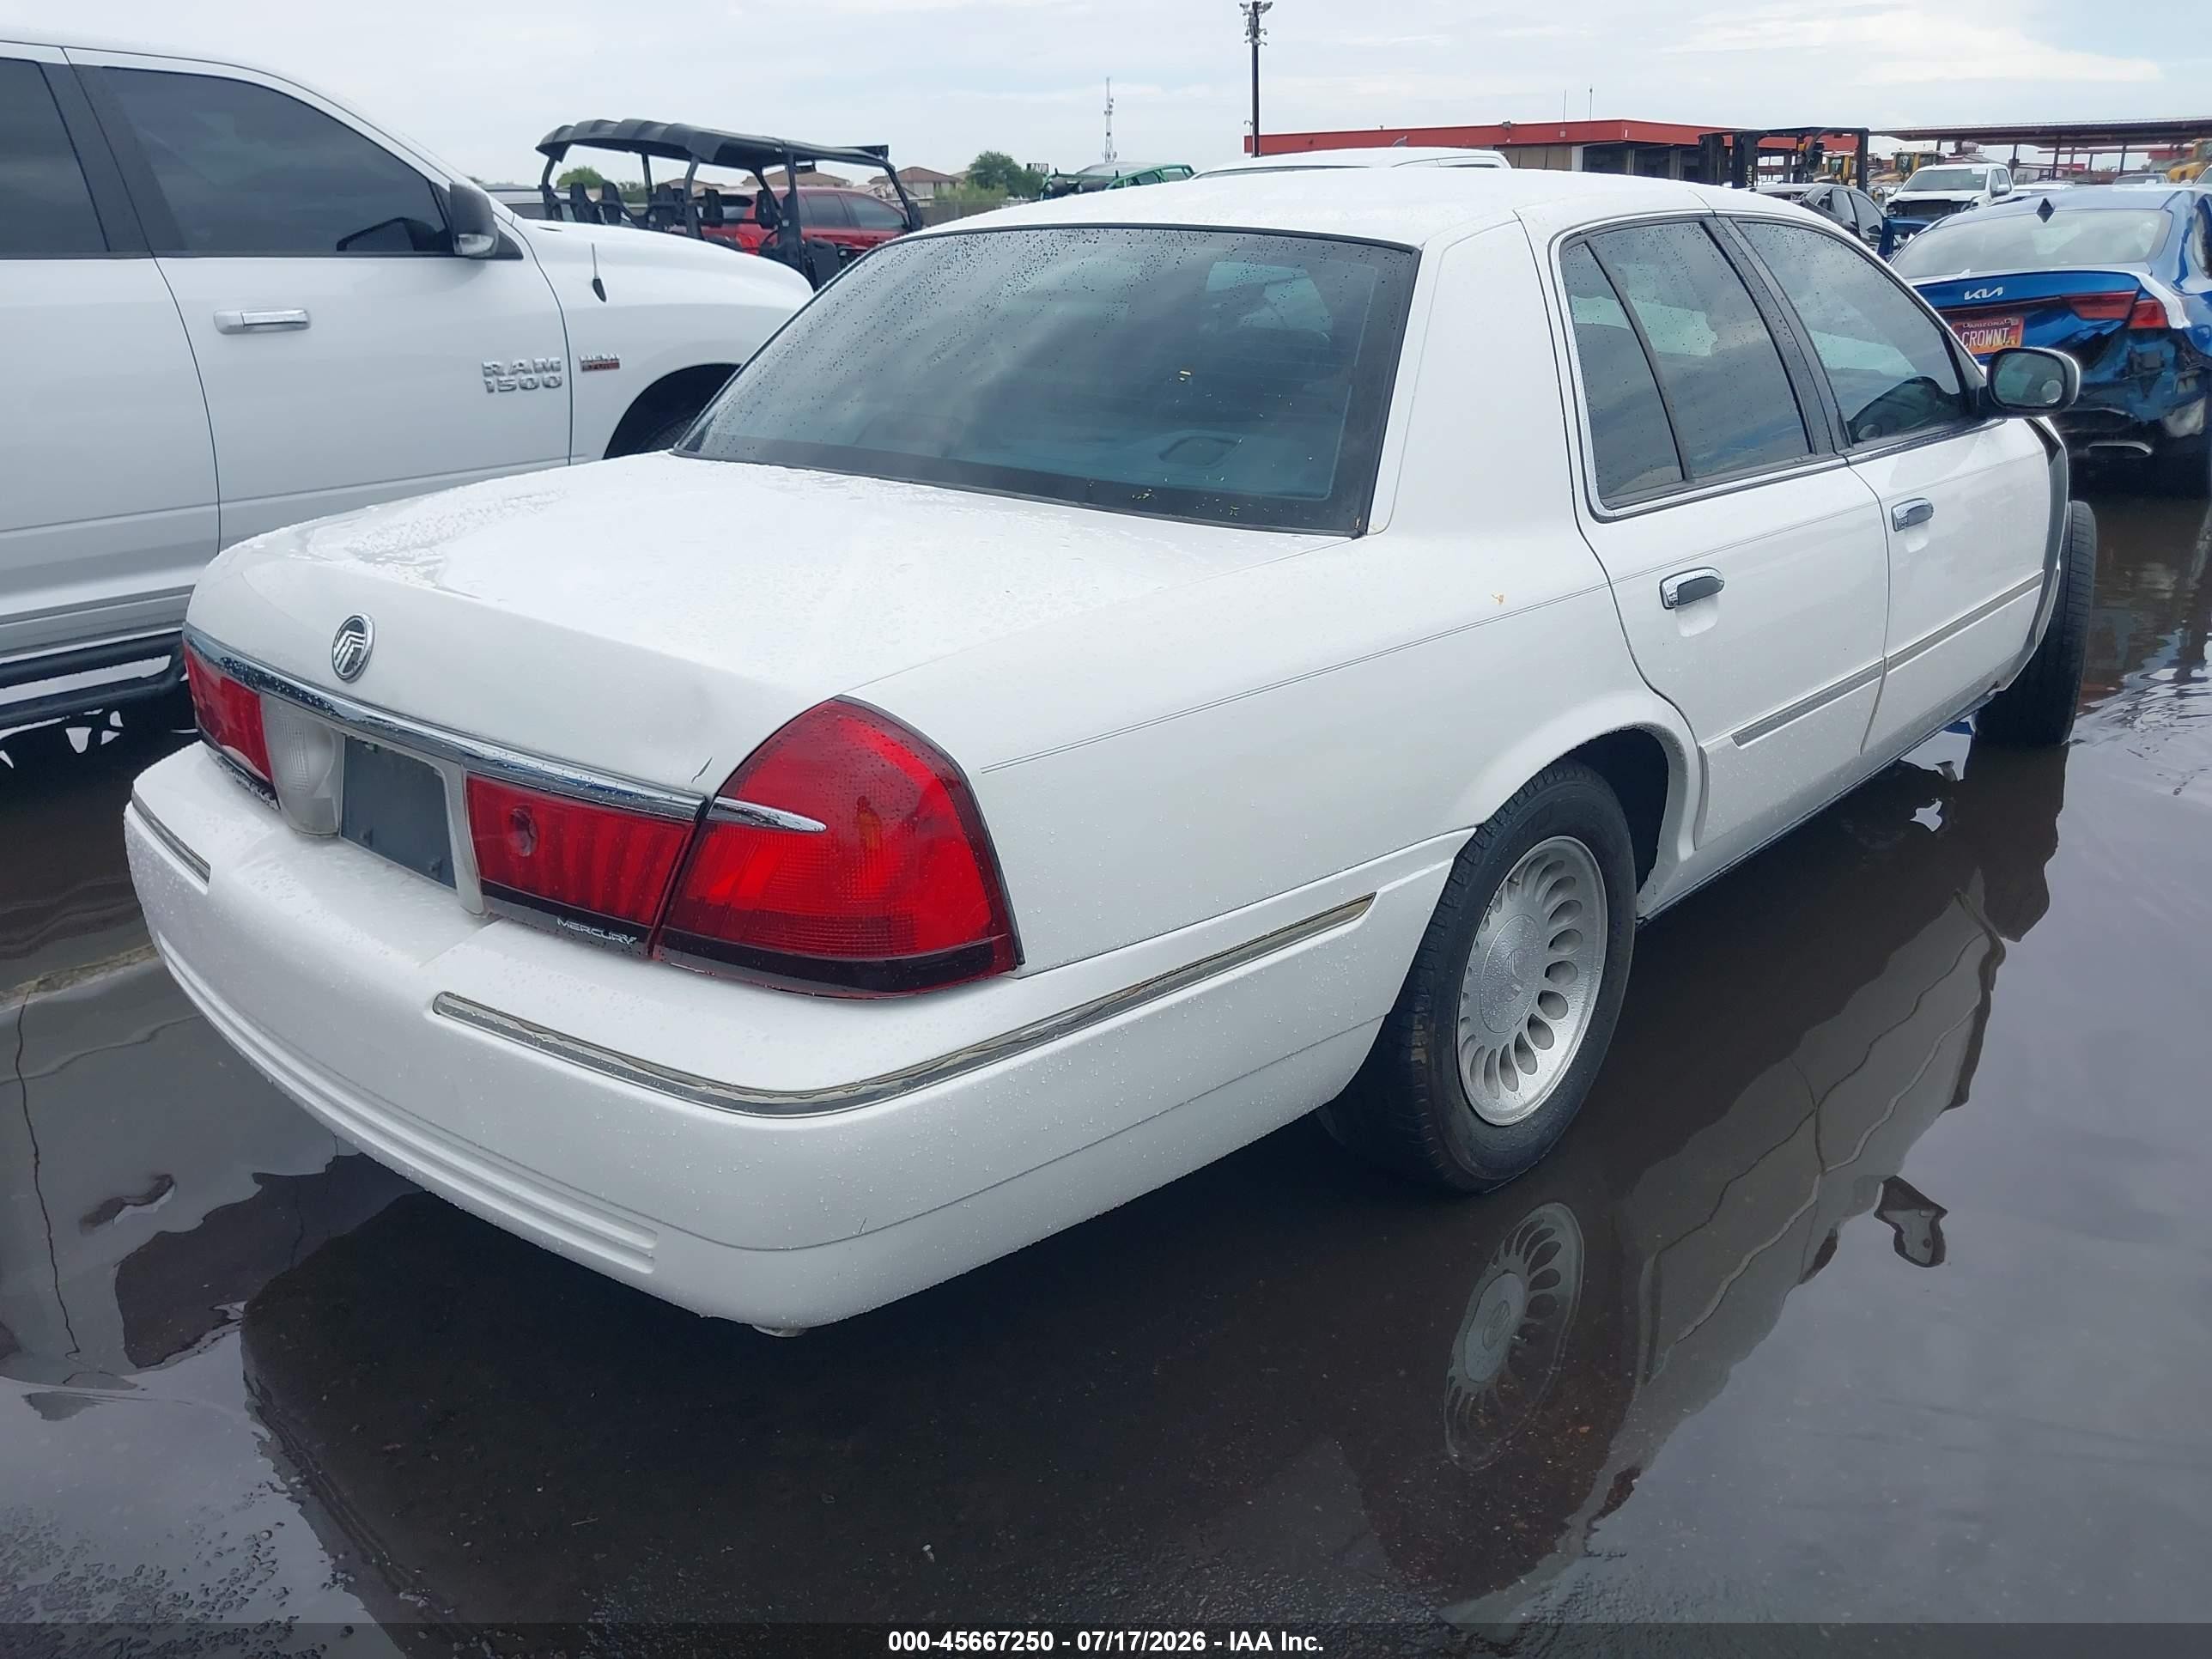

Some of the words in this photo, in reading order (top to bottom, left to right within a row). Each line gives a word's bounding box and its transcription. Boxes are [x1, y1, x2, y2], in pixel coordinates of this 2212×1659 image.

[1964, 286, 2003, 301] KIA
[1961, 327, 2009, 348] CROWNT
[482, 357, 562, 377] RAM
[483, 374, 562, 393] 1500
[556, 917, 637, 945] MERCURY
